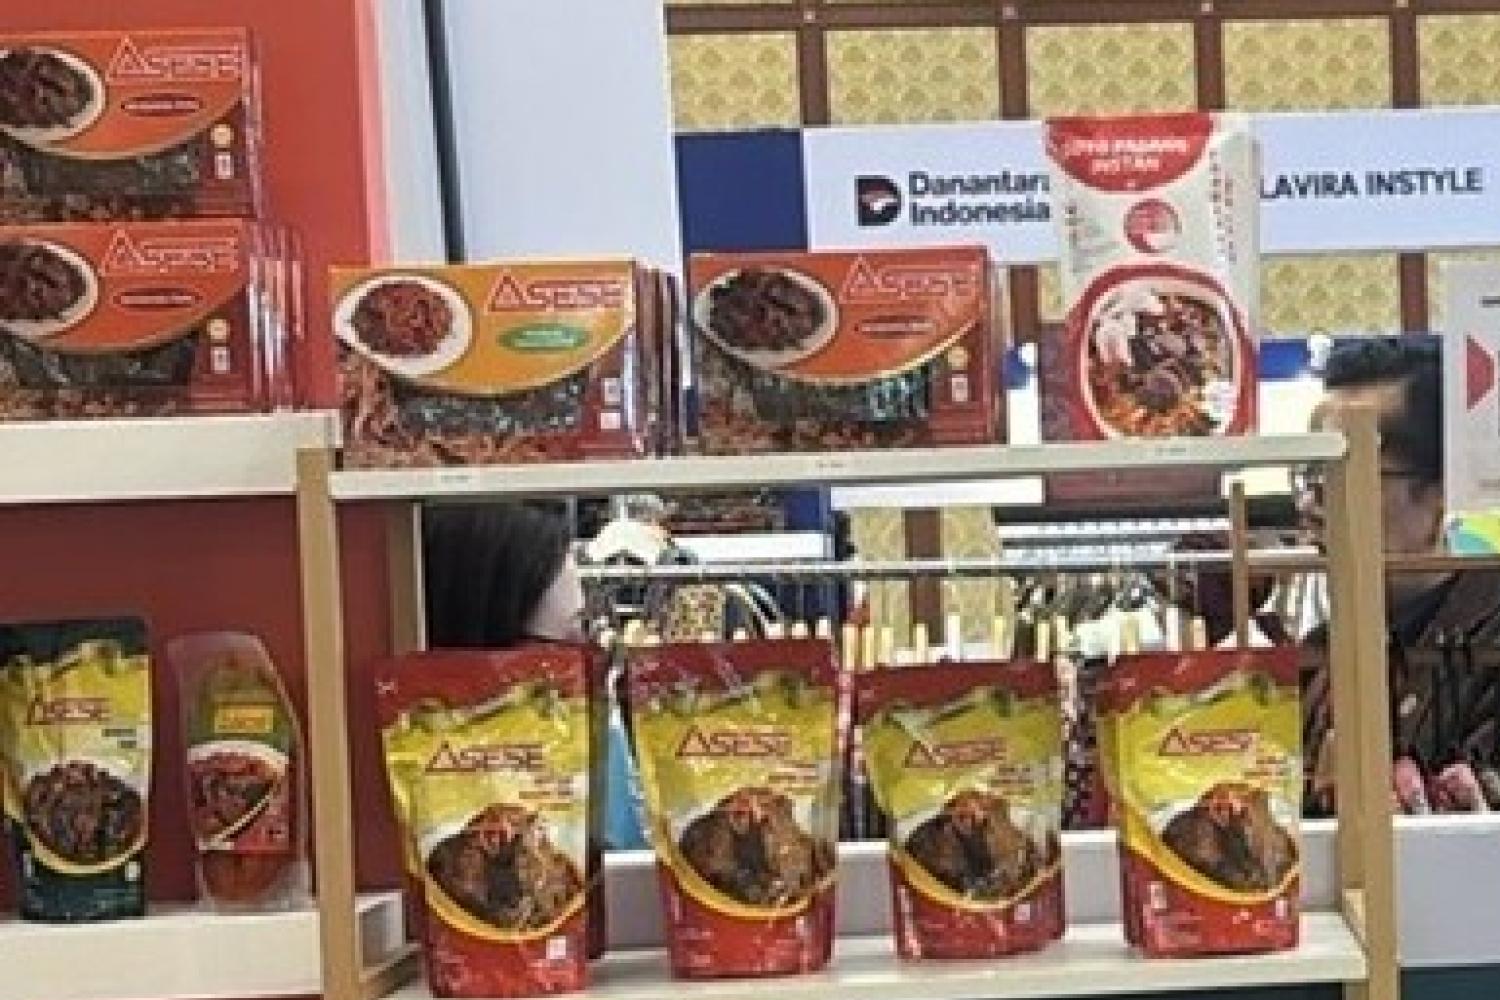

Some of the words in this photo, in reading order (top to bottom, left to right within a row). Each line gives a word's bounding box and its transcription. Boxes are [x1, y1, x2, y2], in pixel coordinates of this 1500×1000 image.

[1259, 172, 1358, 199] LAVIRA
[1366, 167, 1484, 195] INSTYLE
[908, 199, 1051, 226] Indonesia
